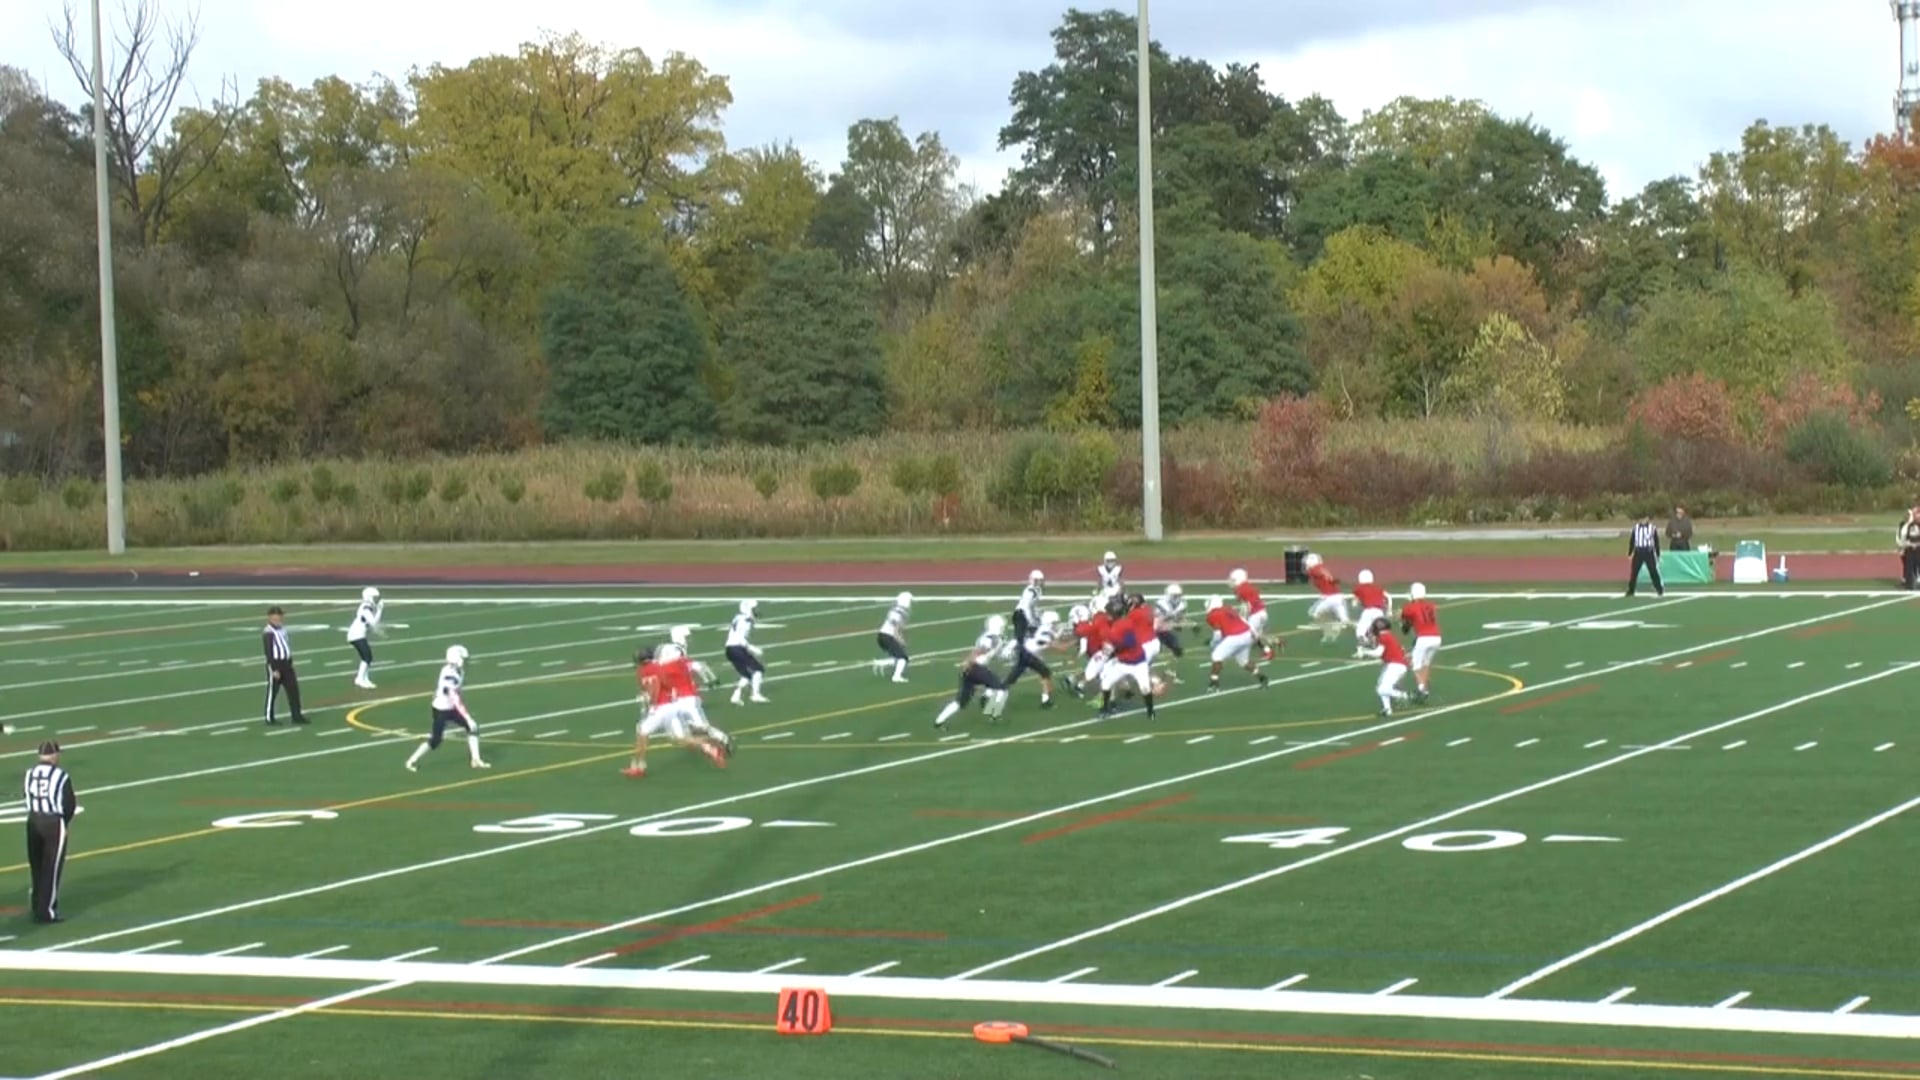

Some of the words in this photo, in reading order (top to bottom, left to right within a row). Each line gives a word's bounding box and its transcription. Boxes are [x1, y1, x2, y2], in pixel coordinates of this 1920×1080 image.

[30, 778, 50, 798] 42
[472, 812, 752, 836] 50
[1220, 826, 1528, 852] 40
[781, 989, 820, 1032] 40
